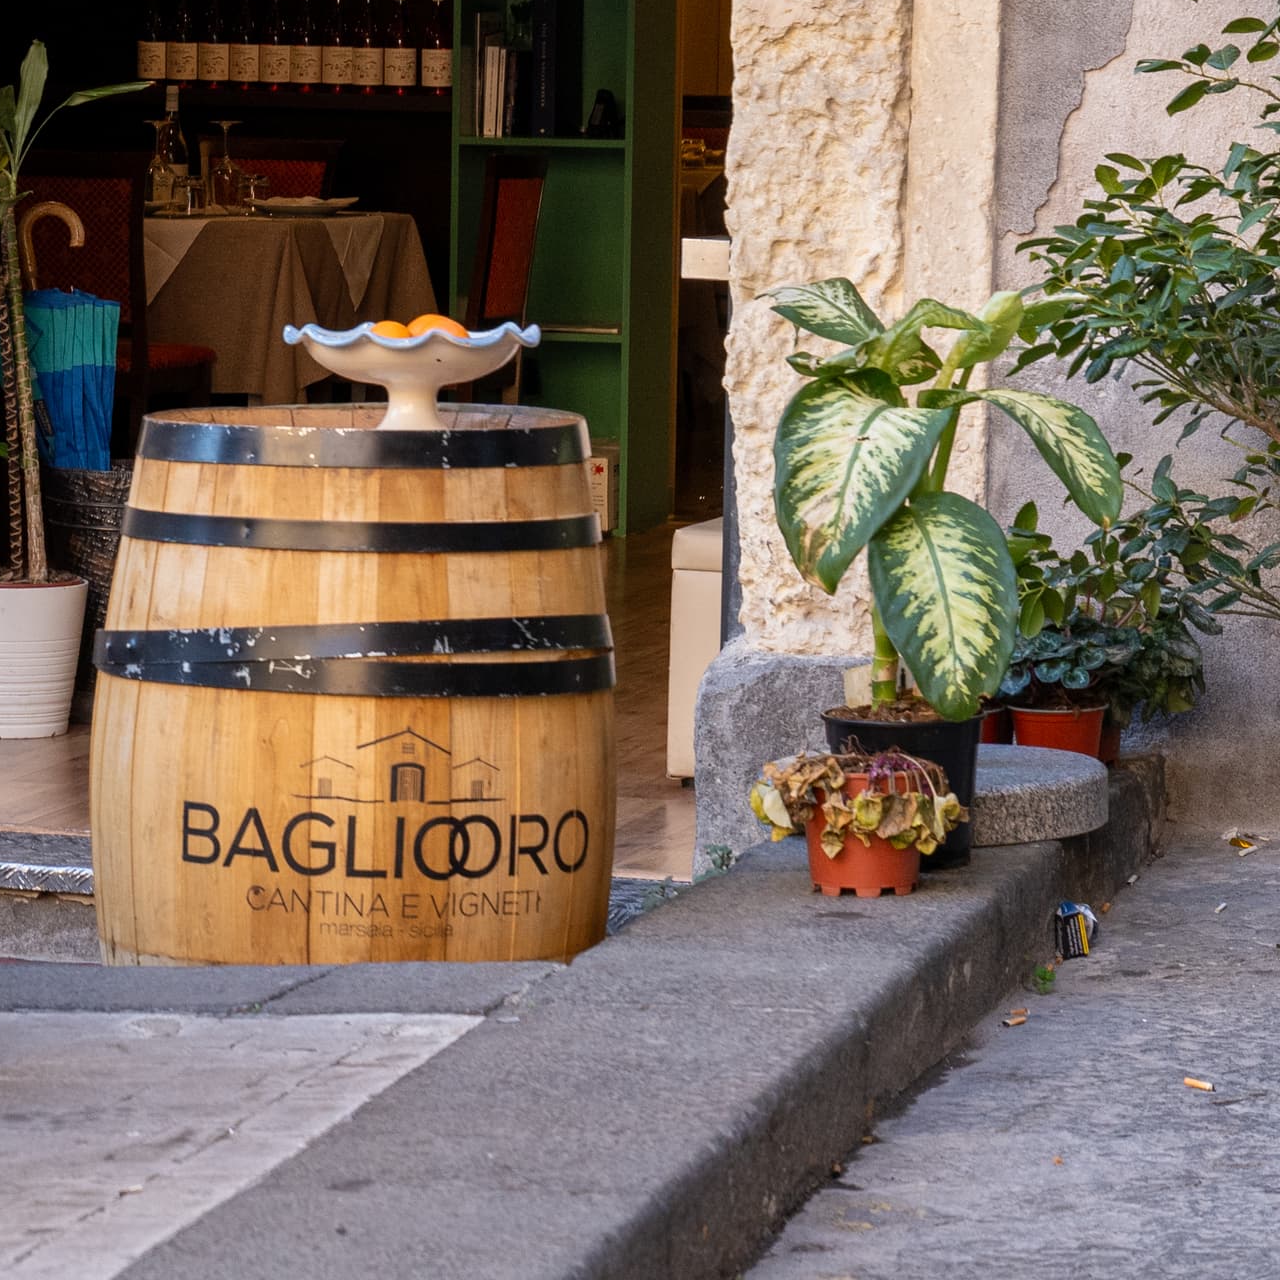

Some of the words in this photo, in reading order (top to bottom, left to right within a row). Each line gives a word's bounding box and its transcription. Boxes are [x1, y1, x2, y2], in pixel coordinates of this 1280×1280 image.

[246, 885, 390, 919] CANTINA
[402, 892, 419, 919] E
[429, 889, 541, 919] VIGNETI
